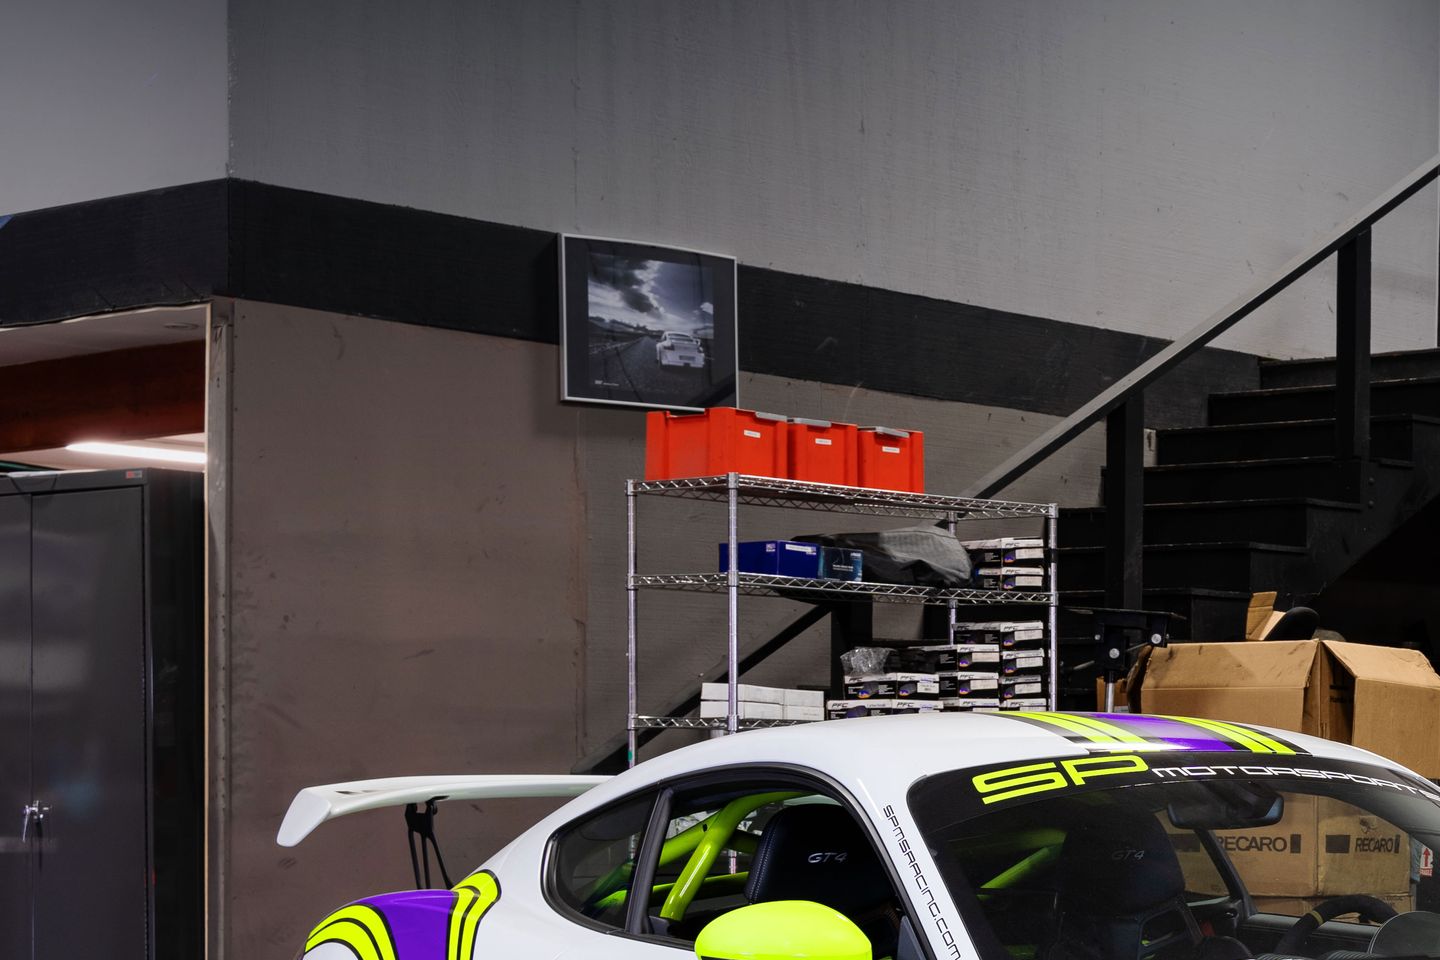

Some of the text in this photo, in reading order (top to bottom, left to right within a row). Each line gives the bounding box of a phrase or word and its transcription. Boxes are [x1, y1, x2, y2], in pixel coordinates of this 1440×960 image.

[972, 755, 1149, 804] SP
[1355, 837, 1394, 853] RECARO
[807, 851, 848, 864] GT4
